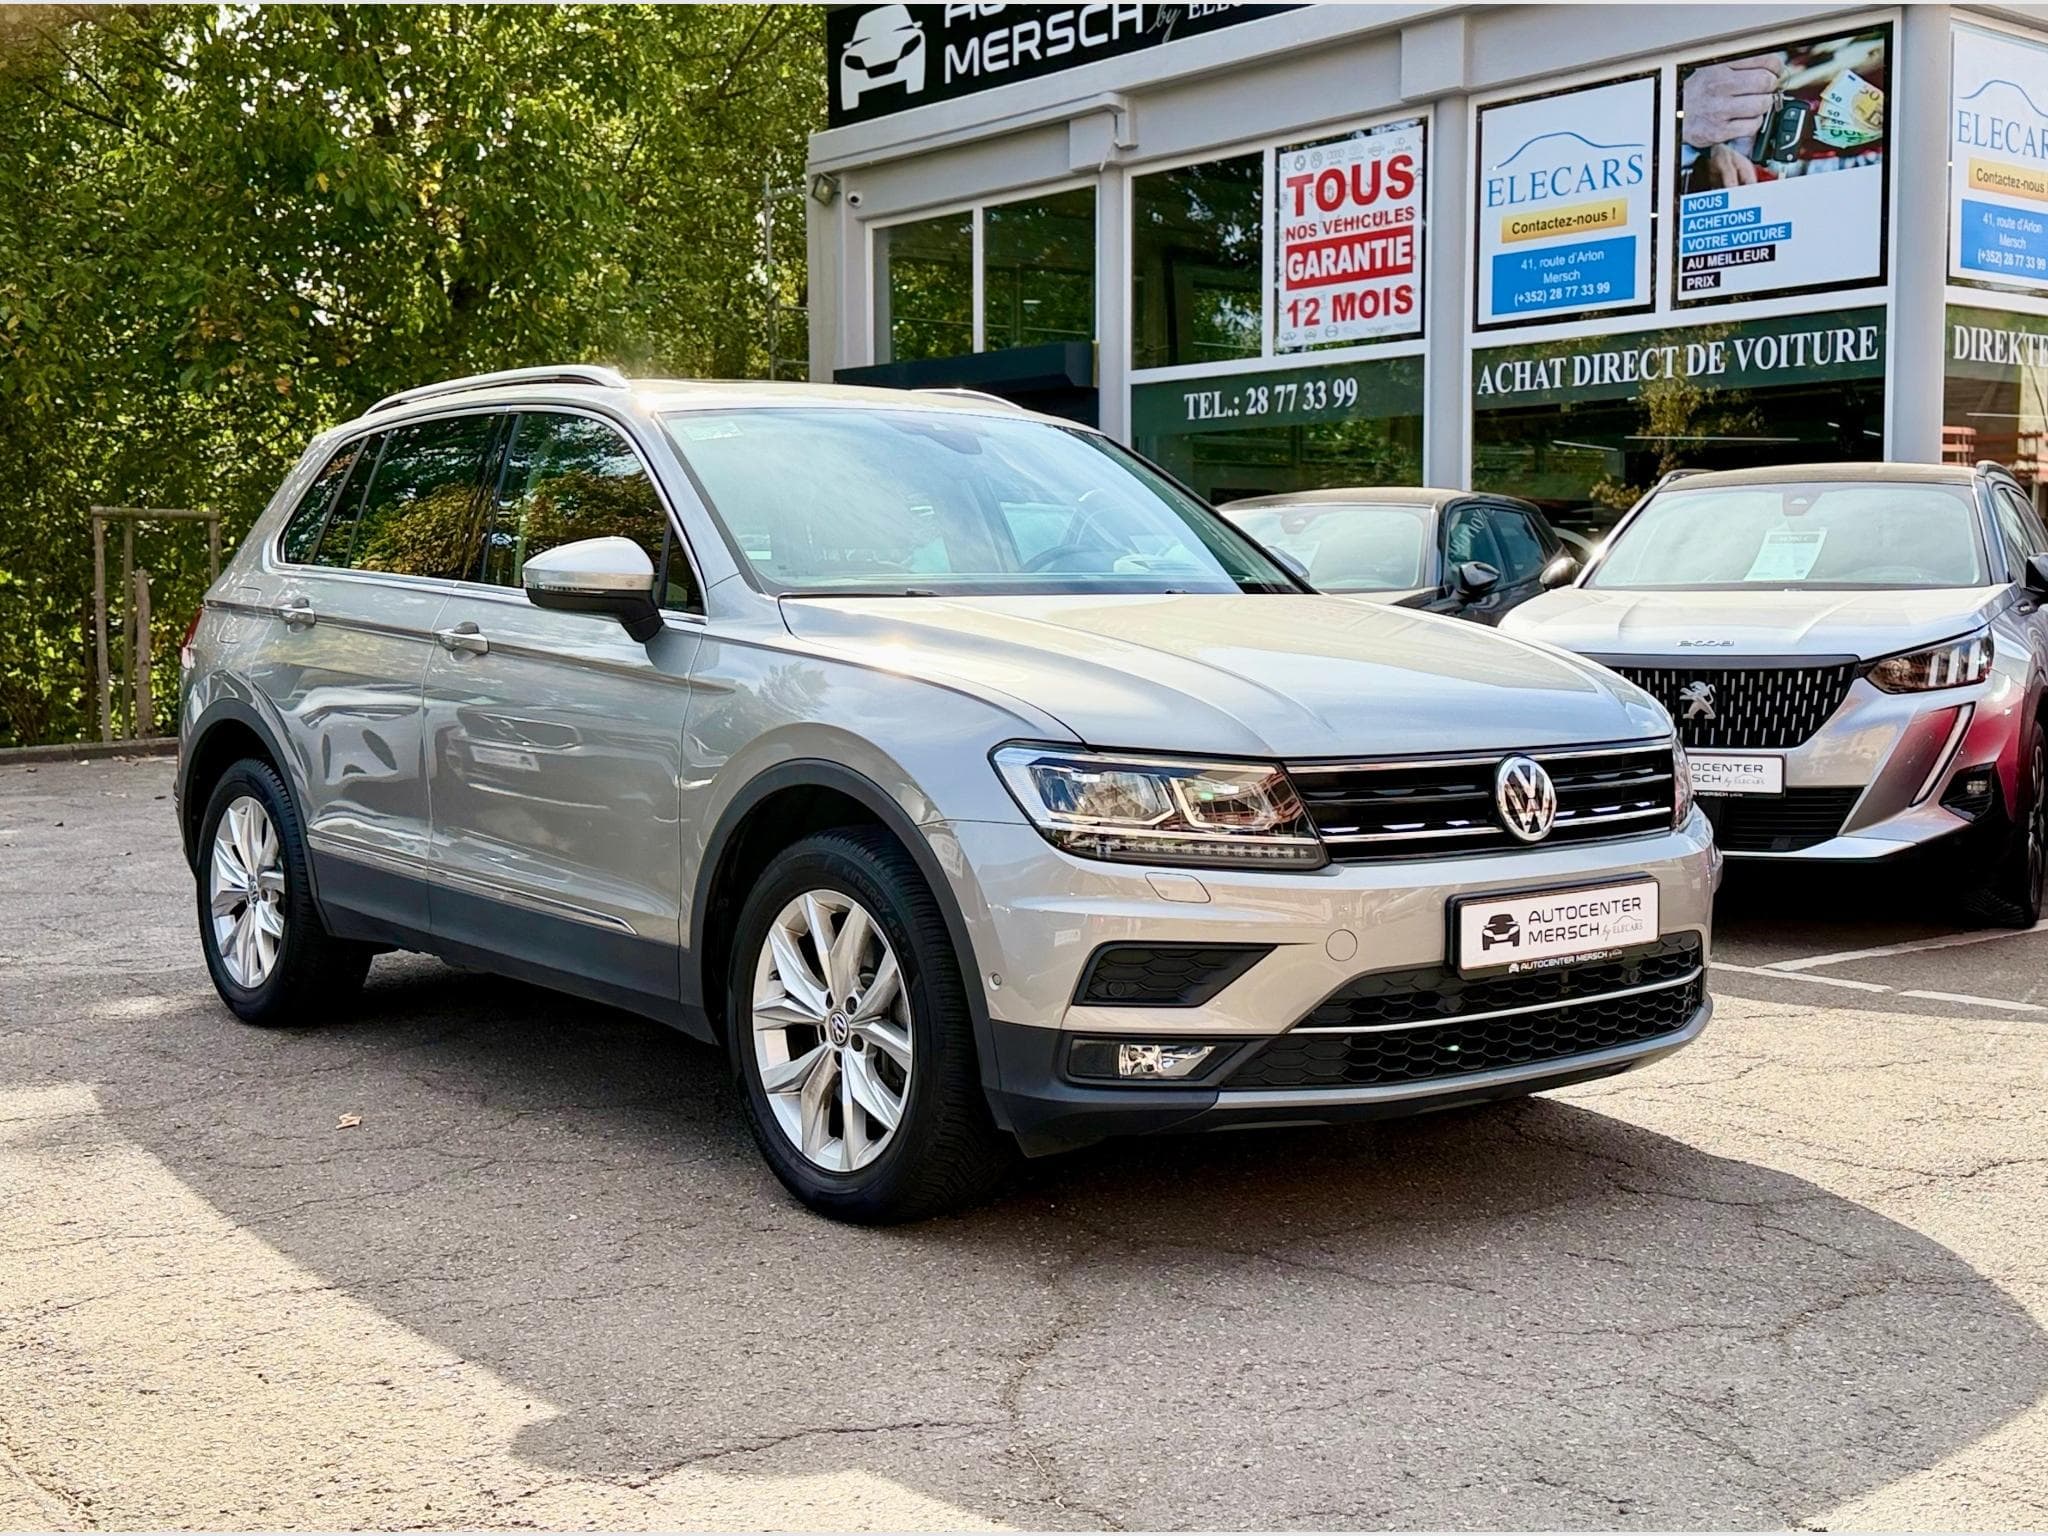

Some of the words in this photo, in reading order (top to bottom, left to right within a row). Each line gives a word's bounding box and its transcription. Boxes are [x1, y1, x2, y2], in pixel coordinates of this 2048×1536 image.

[945, 4, 1143, 84] MERSCH
[1287, 155, 1414, 217] TOUS
[1487, 154, 1644, 208] ELECARS
[1976, 168, 2045, 194] Contactez-nous
[1688, 196, 1722, 211] NOUS
[1286, 224, 1317, 241] NOS
[1512, 211, 1608, 235] Contactez-nous
[1688, 211, 1754, 231] ACHETONS
[1688, 234, 1728, 250] VOTRE
[1732, 226, 1786, 245] VOITURE
[1288, 235, 1411, 282] GARANTIE
[1521, 258, 1537, 270] 41,
[1540, 255, 1565, 268] route
[1568, 250, 1604, 265] d'Arlon
[1687, 257, 1704, 270] AU
[1708, 248, 1769, 266] MEILLEUR
[1544, 269, 1580, 284] Mersch
[1687, 275, 1714, 290] PRIX
[1287, 298, 1320, 328] 12
[1332, 284, 1413, 322] MOIS
[1514, 290, 1547, 306] (+352)
[1550, 287, 1562, 299] 28
[1565, 286, 1578, 298] 77
[1580, 284, 1594, 296] 33
[1597, 282, 1610, 294] 99
[1477, 357, 1566, 395] ACHAT
[1572, 345, 1678, 386] DIRECT
[1686, 341, 1726, 376] DE
[1733, 326, 1879, 372] VOITURE
[1184, 390, 1240, 420] TEL.:
[1246, 386, 1269, 415] 28
[1274, 384, 1298, 412] 77
[1302, 380, 1327, 410] 33
[1333, 377, 1358, 408] 99
[1689, 762, 1763, 773] OCENTER
[1528, 897, 1641, 925] AUTOCENTER
[1528, 924, 1600, 946] MERSCH
[1520, 956, 1574, 970] AUTOCENTER
